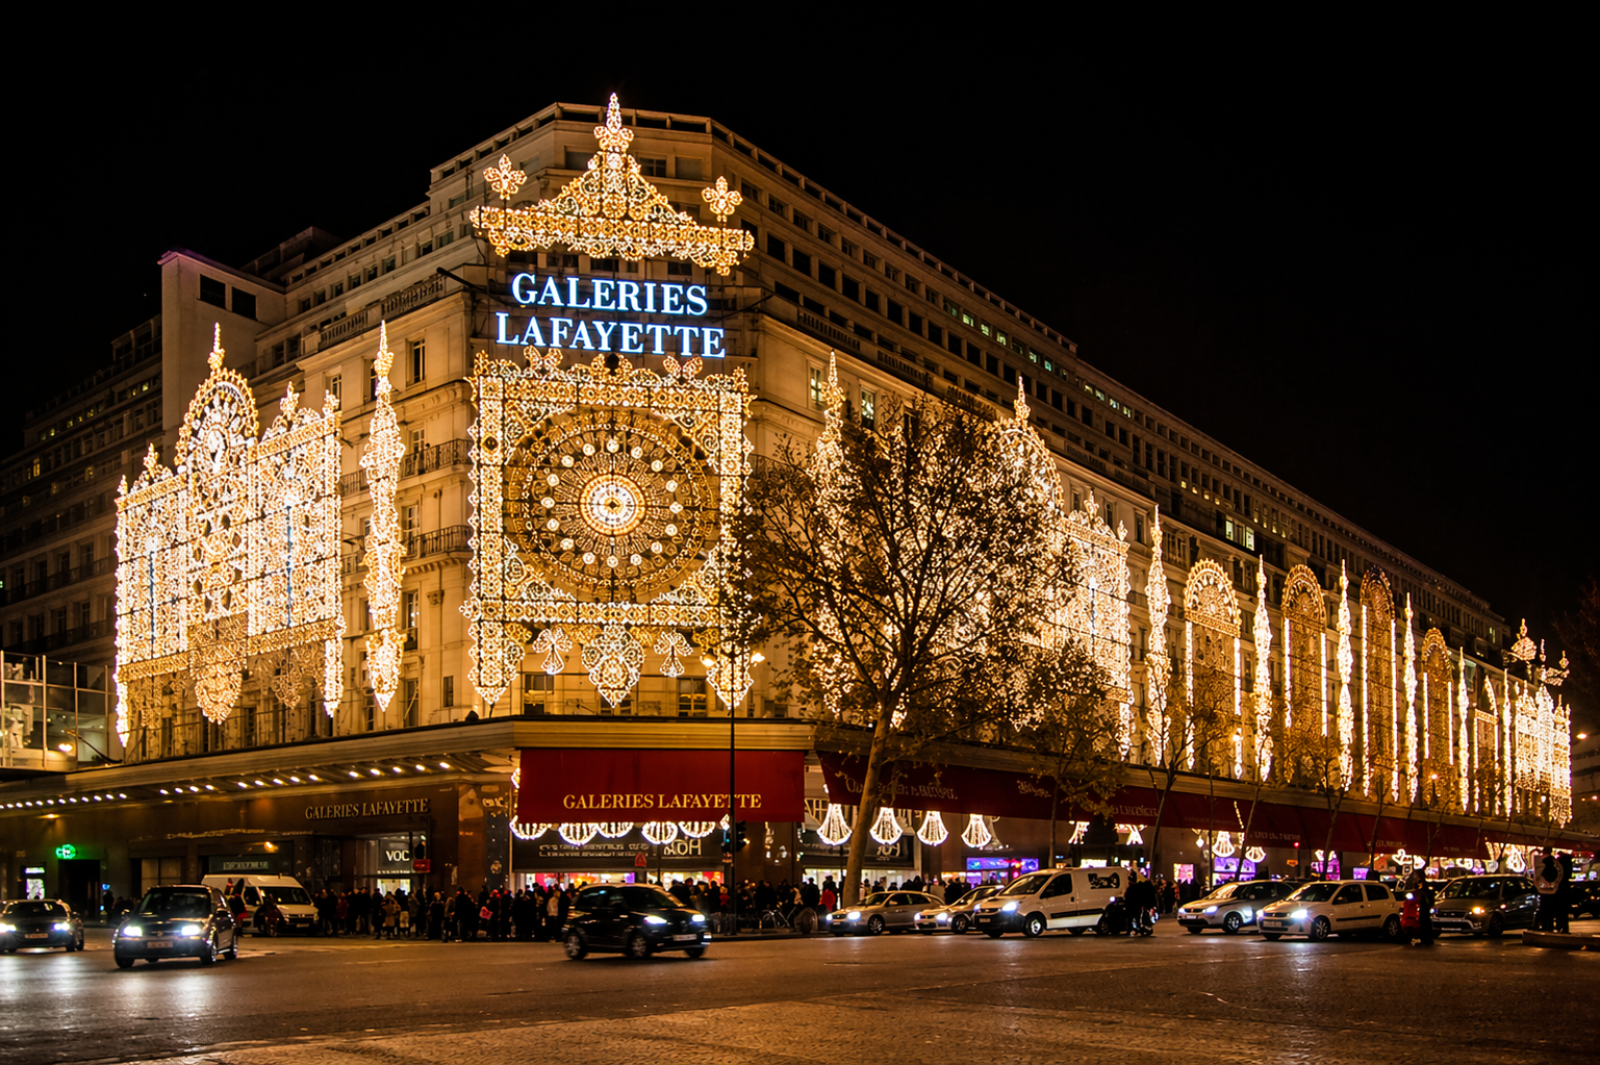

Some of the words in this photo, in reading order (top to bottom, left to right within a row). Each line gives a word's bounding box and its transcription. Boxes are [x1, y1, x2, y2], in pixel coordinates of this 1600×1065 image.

[511, 272, 708, 316] GALERIES
[495, 311, 726, 358] LAFAYETTE
[305, 803, 359, 820] GALERIES
[362, 798, 428, 816] LAFAYETTE
[563, 793, 654, 809] GALERIES
[657, 793, 762, 809] LAFAYETTE
